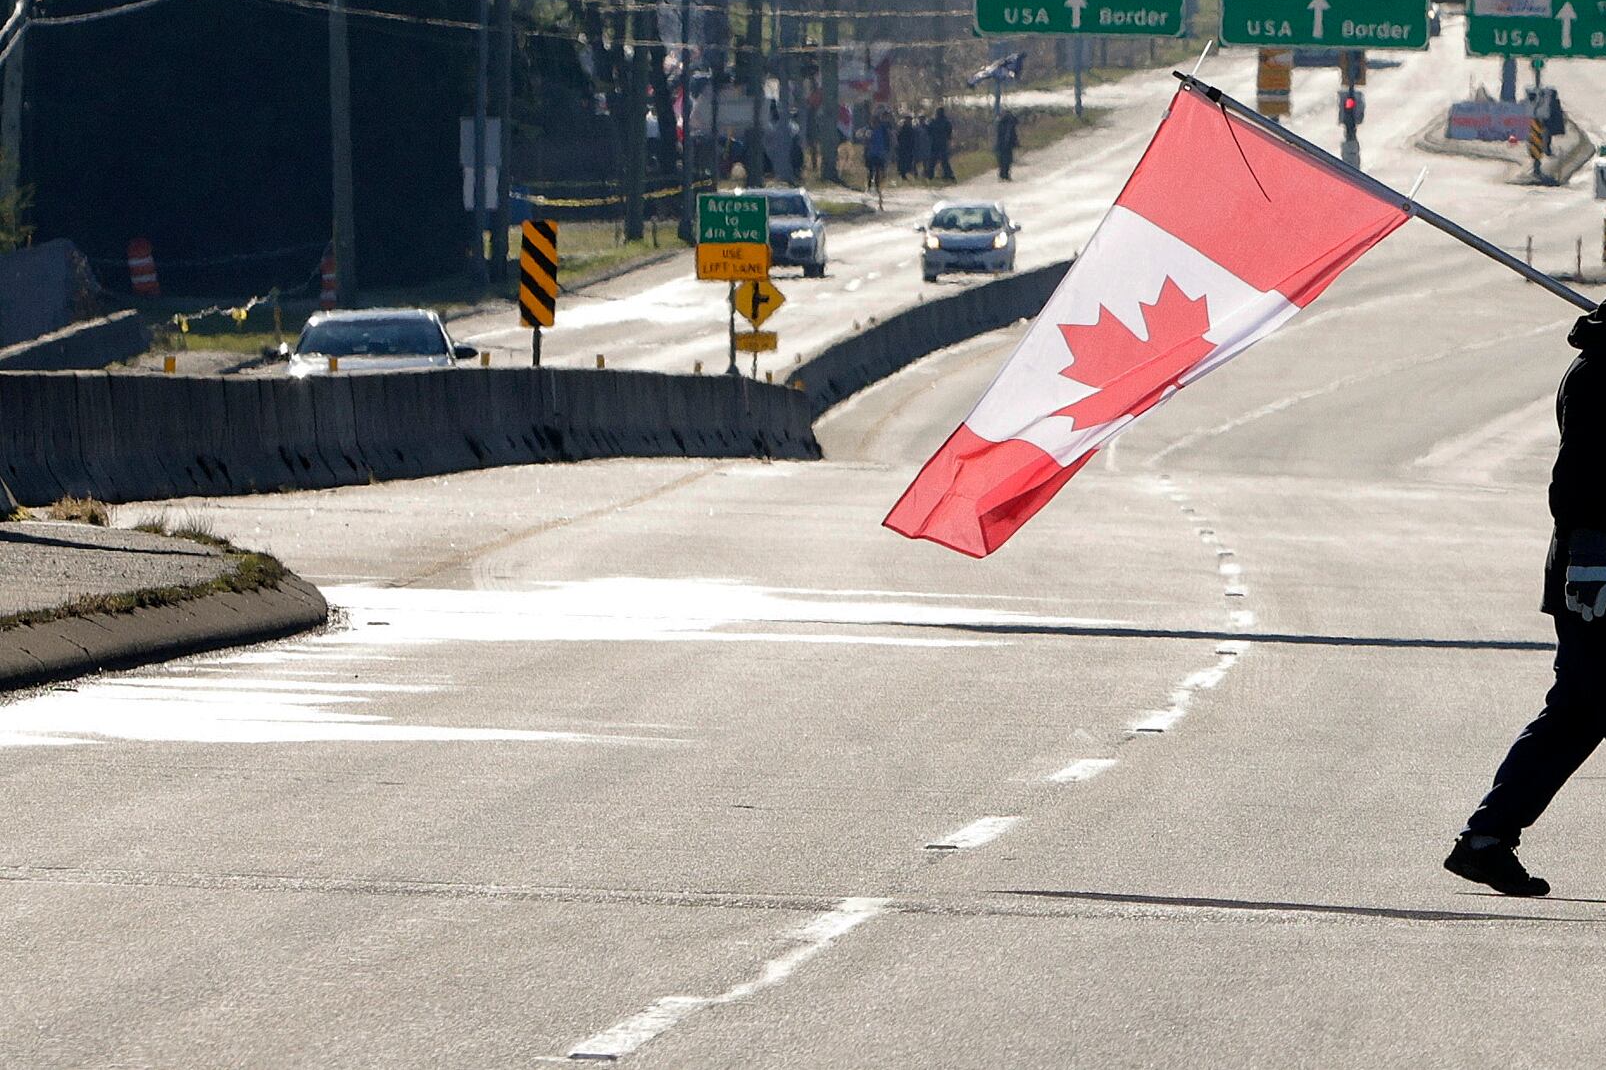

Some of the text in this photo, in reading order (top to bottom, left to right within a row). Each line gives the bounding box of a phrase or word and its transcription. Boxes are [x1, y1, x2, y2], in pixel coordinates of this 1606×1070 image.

[1004, 8, 1169, 27] USA Border
[1247, 20, 1412, 40] USA Border
[1494, 28, 1540, 46] USA
[722, 249, 742, 259] USE
